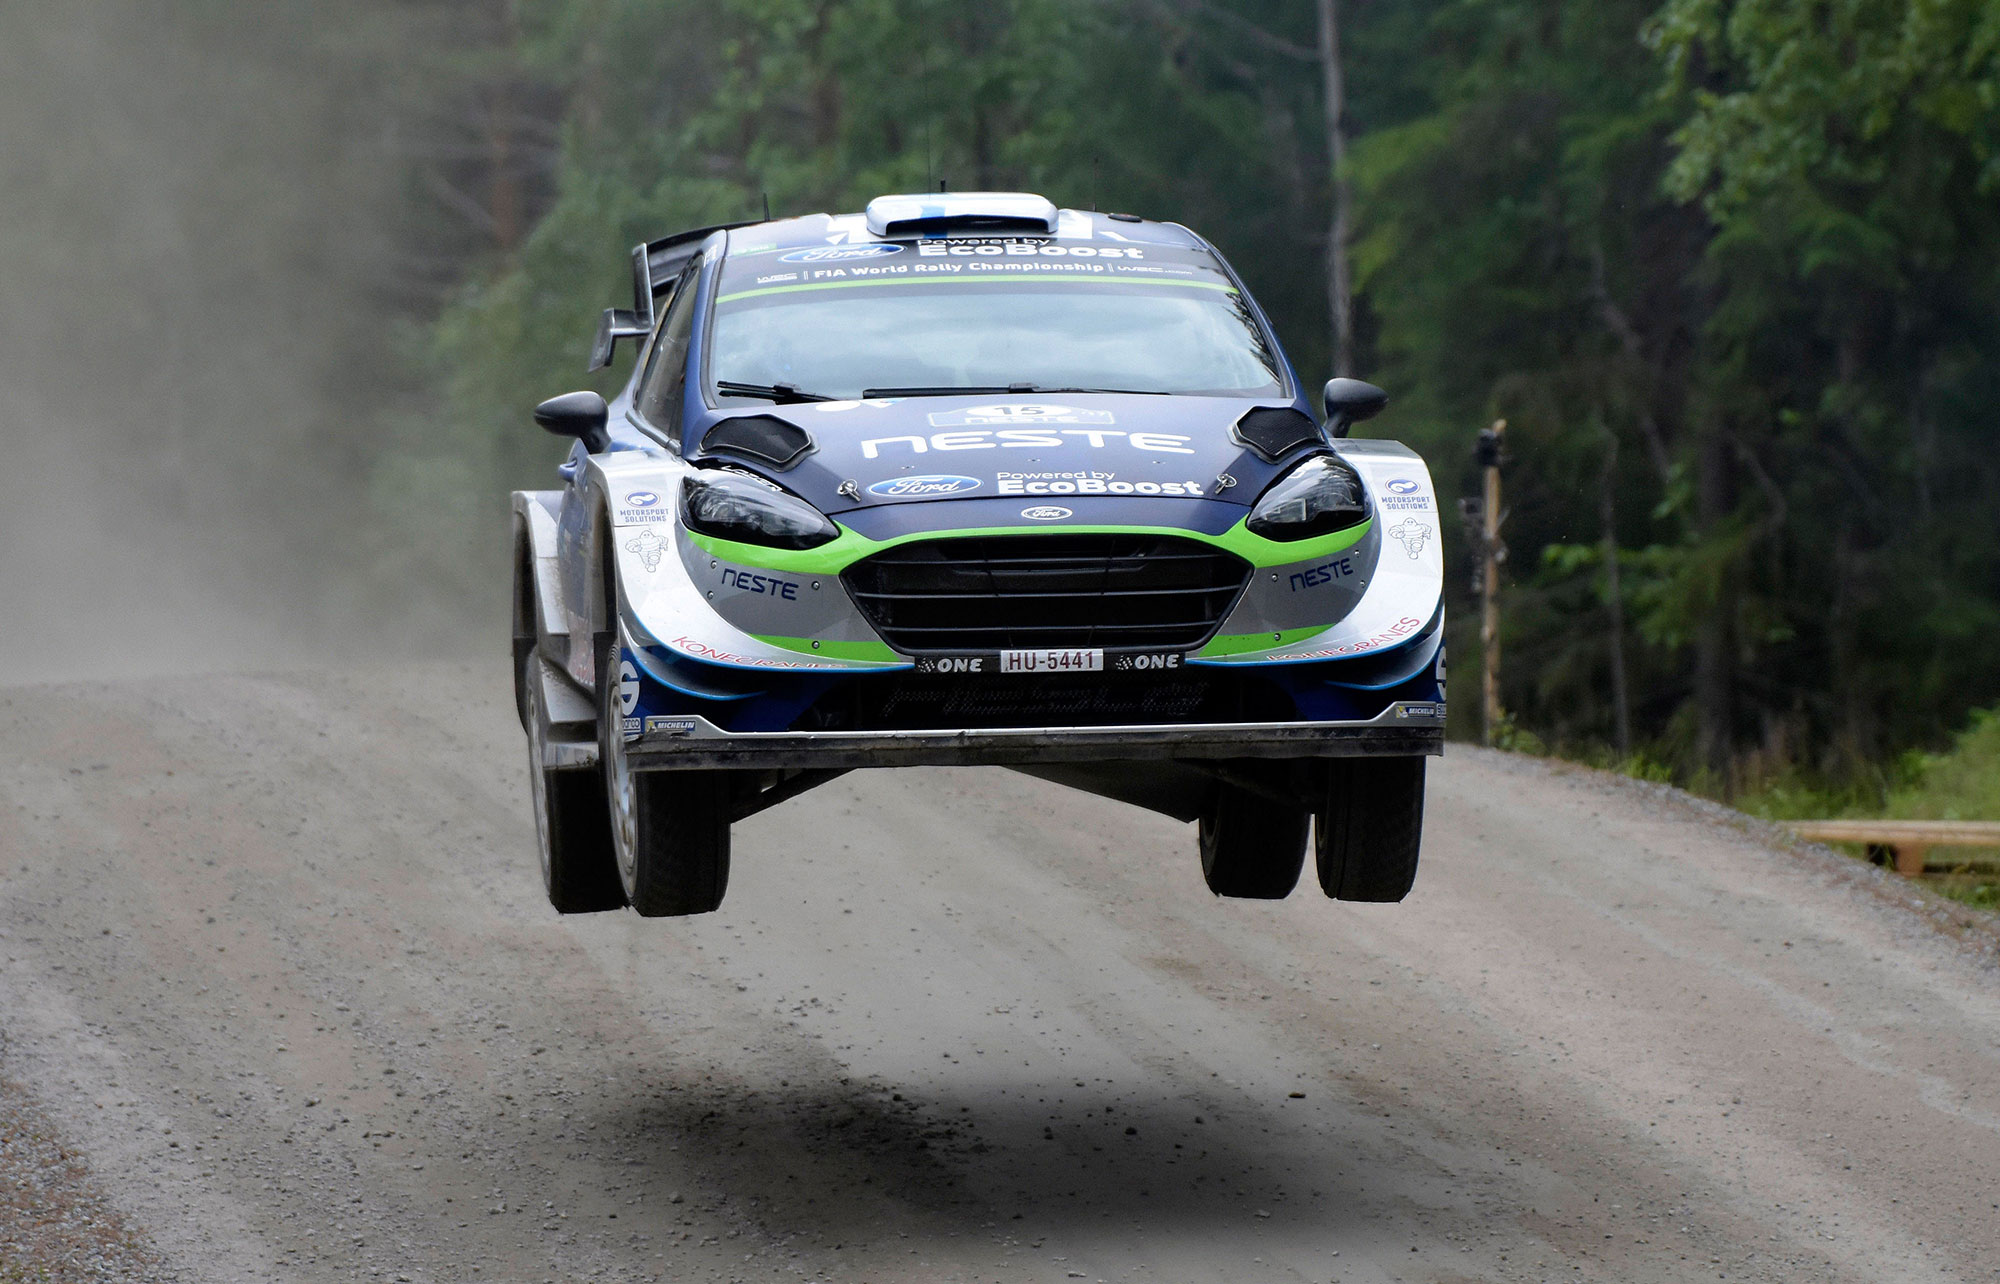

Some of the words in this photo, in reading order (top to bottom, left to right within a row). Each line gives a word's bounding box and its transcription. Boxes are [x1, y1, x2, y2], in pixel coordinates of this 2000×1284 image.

[1023, 238, 1050, 247] by
[918, 243, 1144, 259] EcoBoost
[814, 268, 847, 279] FIA
[851, 264, 908, 275] World
[914, 263, 963, 273] Rally
[968, 262, 1105, 273] Championship
[994, 406, 1045, 416] 15
[997, 471, 1086, 480] Powered
[1094, 470, 1115, 482] by
[998, 478, 1204, 496] EcoBoost
[1381, 496, 1430, 504] MOTORSPORT
[1386, 502, 1429, 510] SOLUTIONS
[619, 508, 670, 517] MOTORSPORT
[624, 515, 667, 523] SOLUTIONS
[936, 657, 984, 673] ONE
[1008, 651, 1094, 671] HU-5441
[1132, 653, 1180, 669] ONE
[657, 721, 695, 729] MICHELIN
